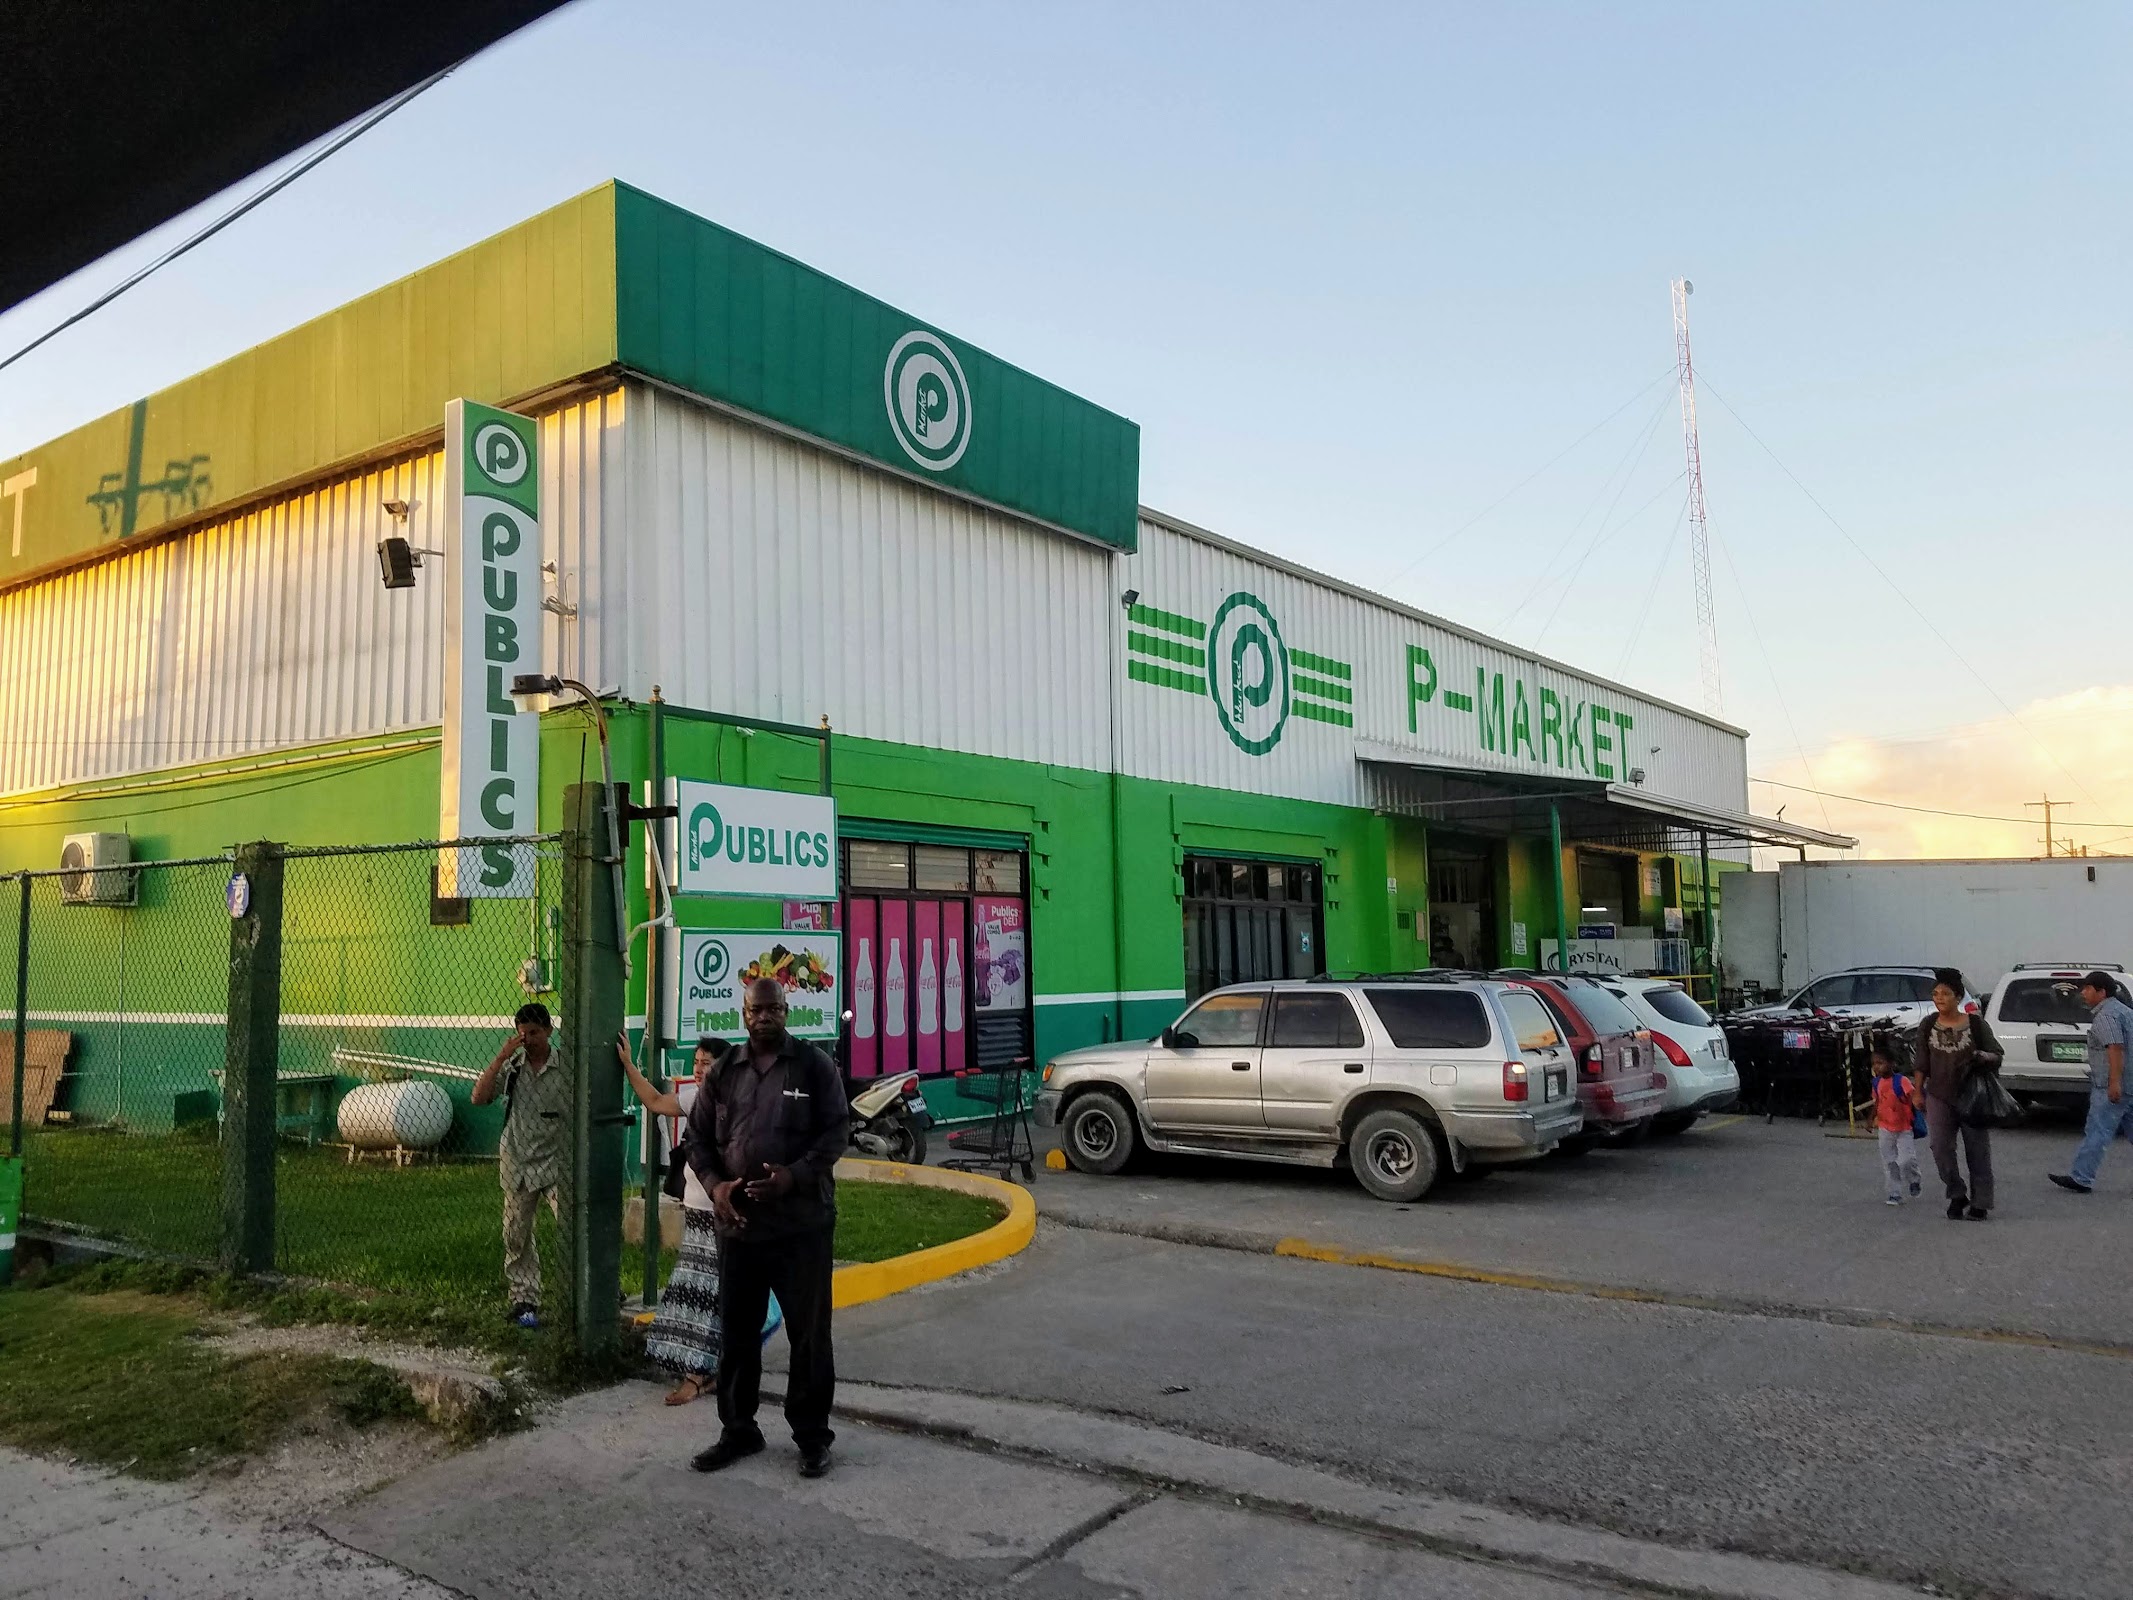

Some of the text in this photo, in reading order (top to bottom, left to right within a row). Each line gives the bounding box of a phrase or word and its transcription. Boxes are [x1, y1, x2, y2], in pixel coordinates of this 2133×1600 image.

[917, 388, 926, 433] Market
[486, 432, 519, 473] P
[0, 466, 37, 557] T
[480, 512, 520, 888] PUBLICS
[1406, 643, 1633, 783] P-MARKET
[689, 802, 829, 871] PUBLICS
[991, 905, 1018, 917] Publics
[1003, 917, 1017, 926] DELI
[689, 985, 733, 1000] PUBLICS
[696, 1007, 740, 1032] Fresh
